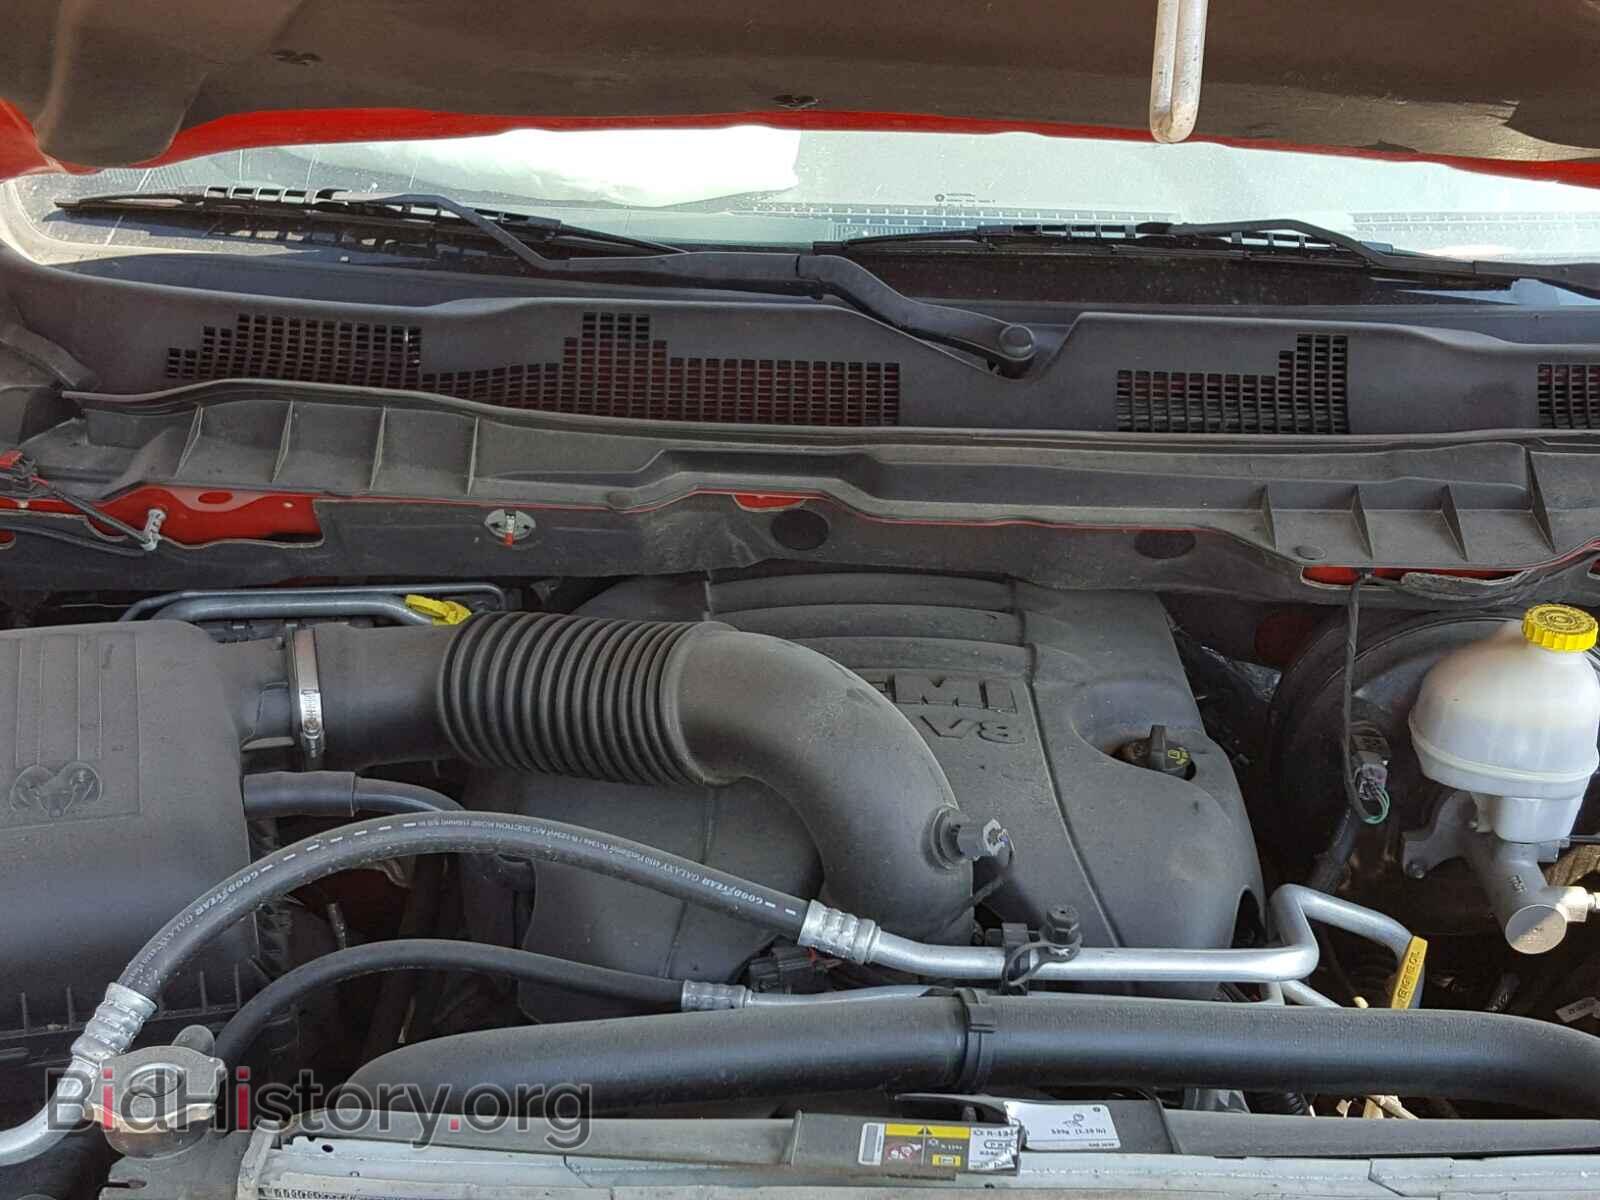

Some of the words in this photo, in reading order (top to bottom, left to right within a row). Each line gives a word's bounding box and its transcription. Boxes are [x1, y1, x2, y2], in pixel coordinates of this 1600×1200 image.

[918, 714, 1027, 745] V8
[495, 821, 531, 833] SUCTION
[662, 863, 700, 881] GALAXY
[195, 871, 260, 914] GOODYEAR
[701, 878, 764, 905] GOODYEAR
[156, 914, 194, 950] GALAXY
